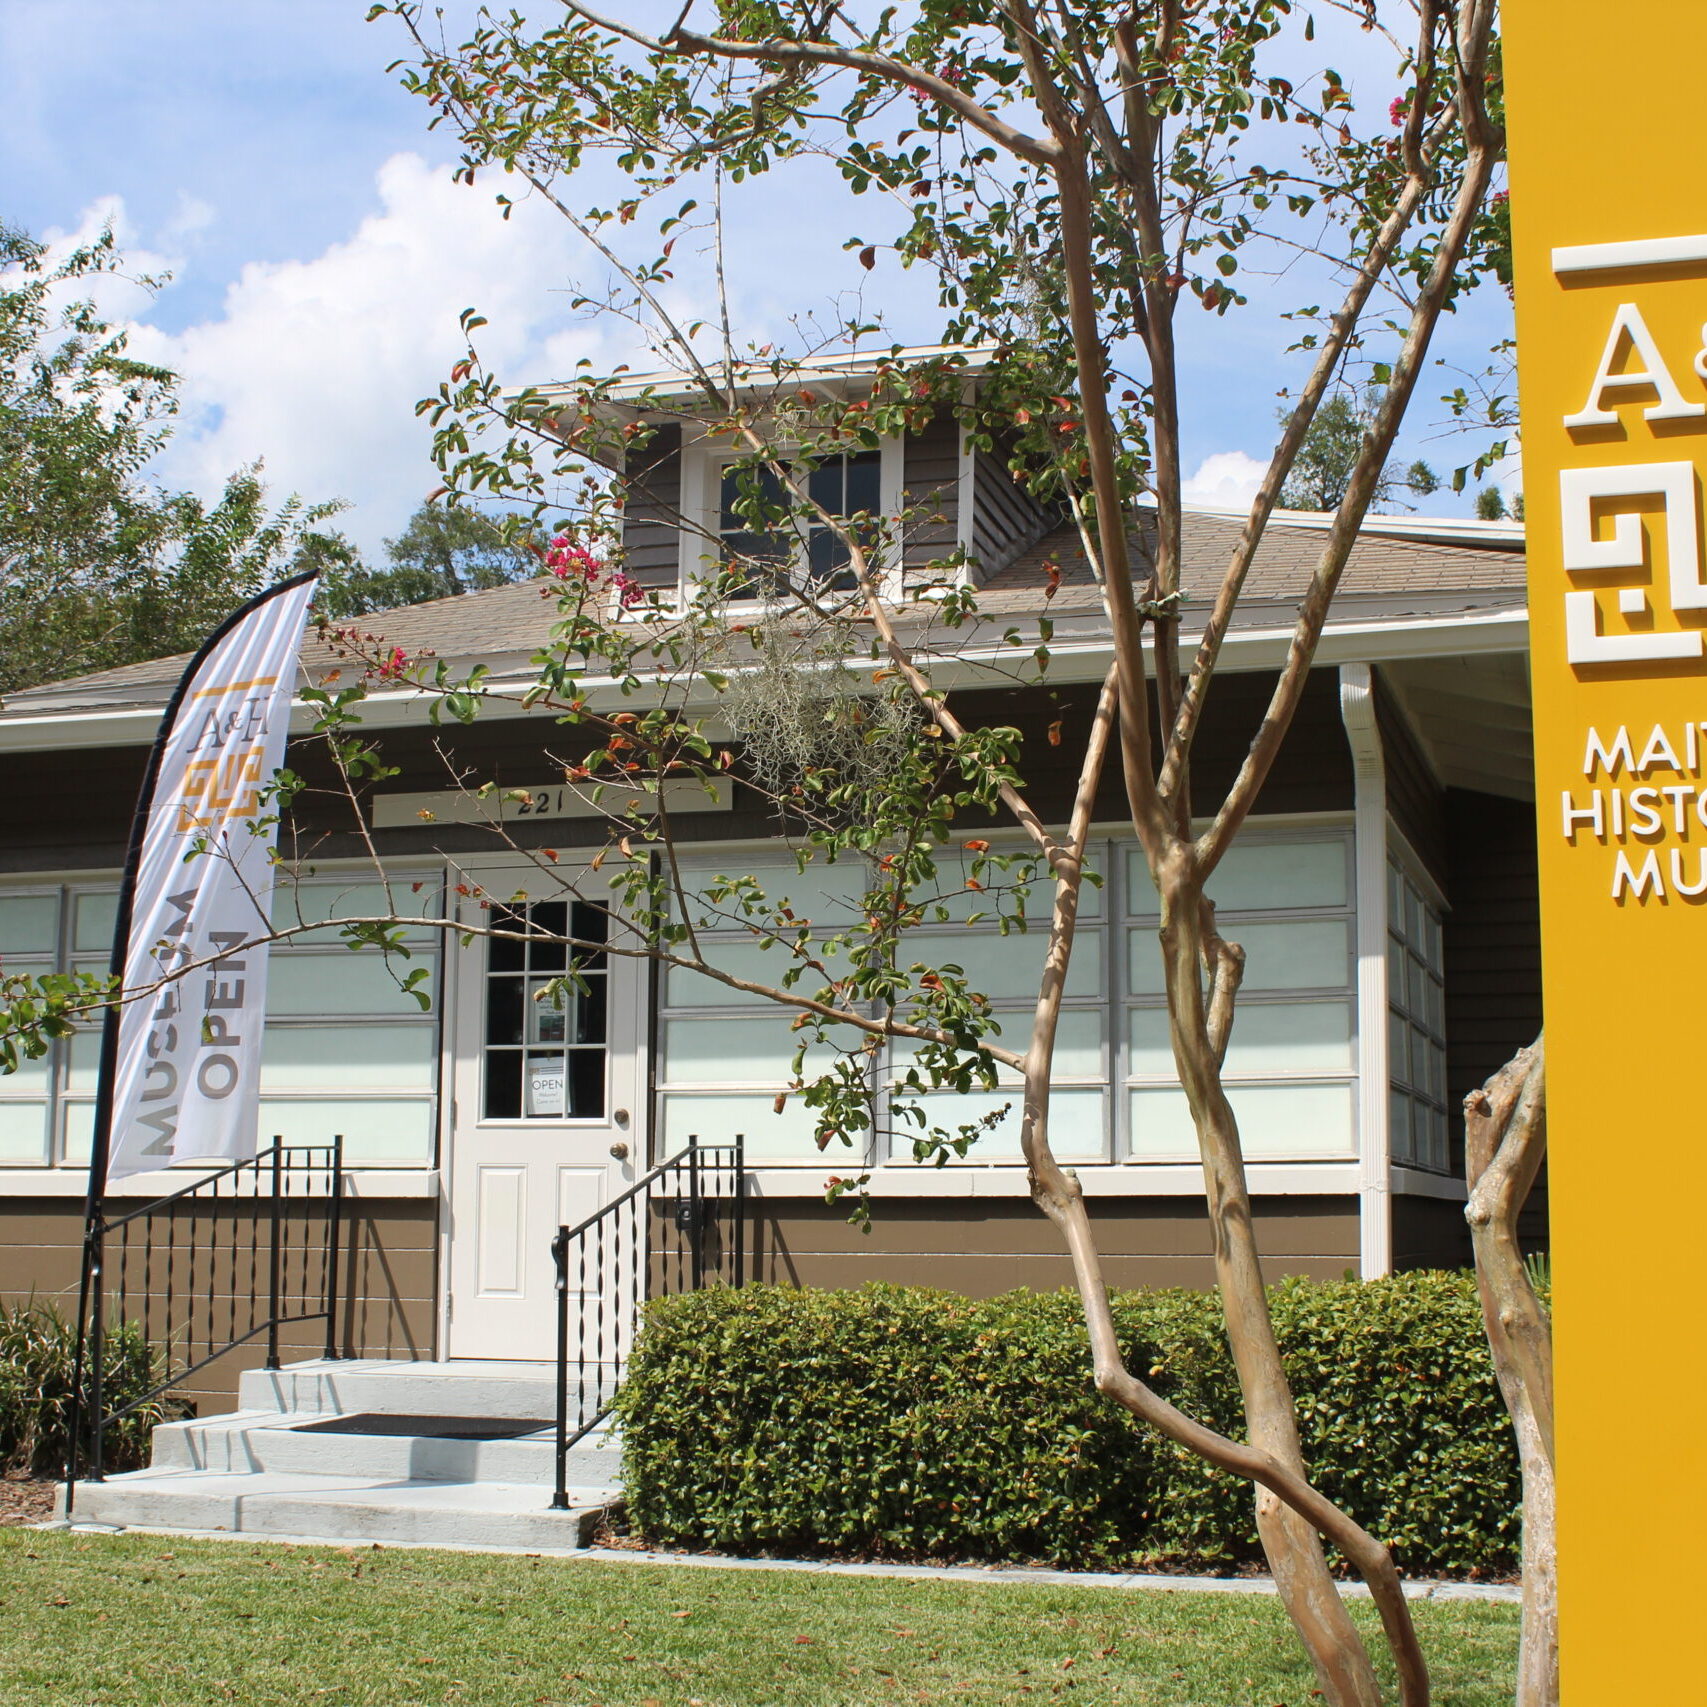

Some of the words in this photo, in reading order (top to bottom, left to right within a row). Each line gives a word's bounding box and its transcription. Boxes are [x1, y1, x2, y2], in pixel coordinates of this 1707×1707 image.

[1583, 722, 1707, 775] MAI
[1561, 785, 1707, 838] HIST
[1611, 847, 1707, 898] MU
[197, 931, 249, 1100] OPEN
[532, 1079, 563, 1090] OPEN
